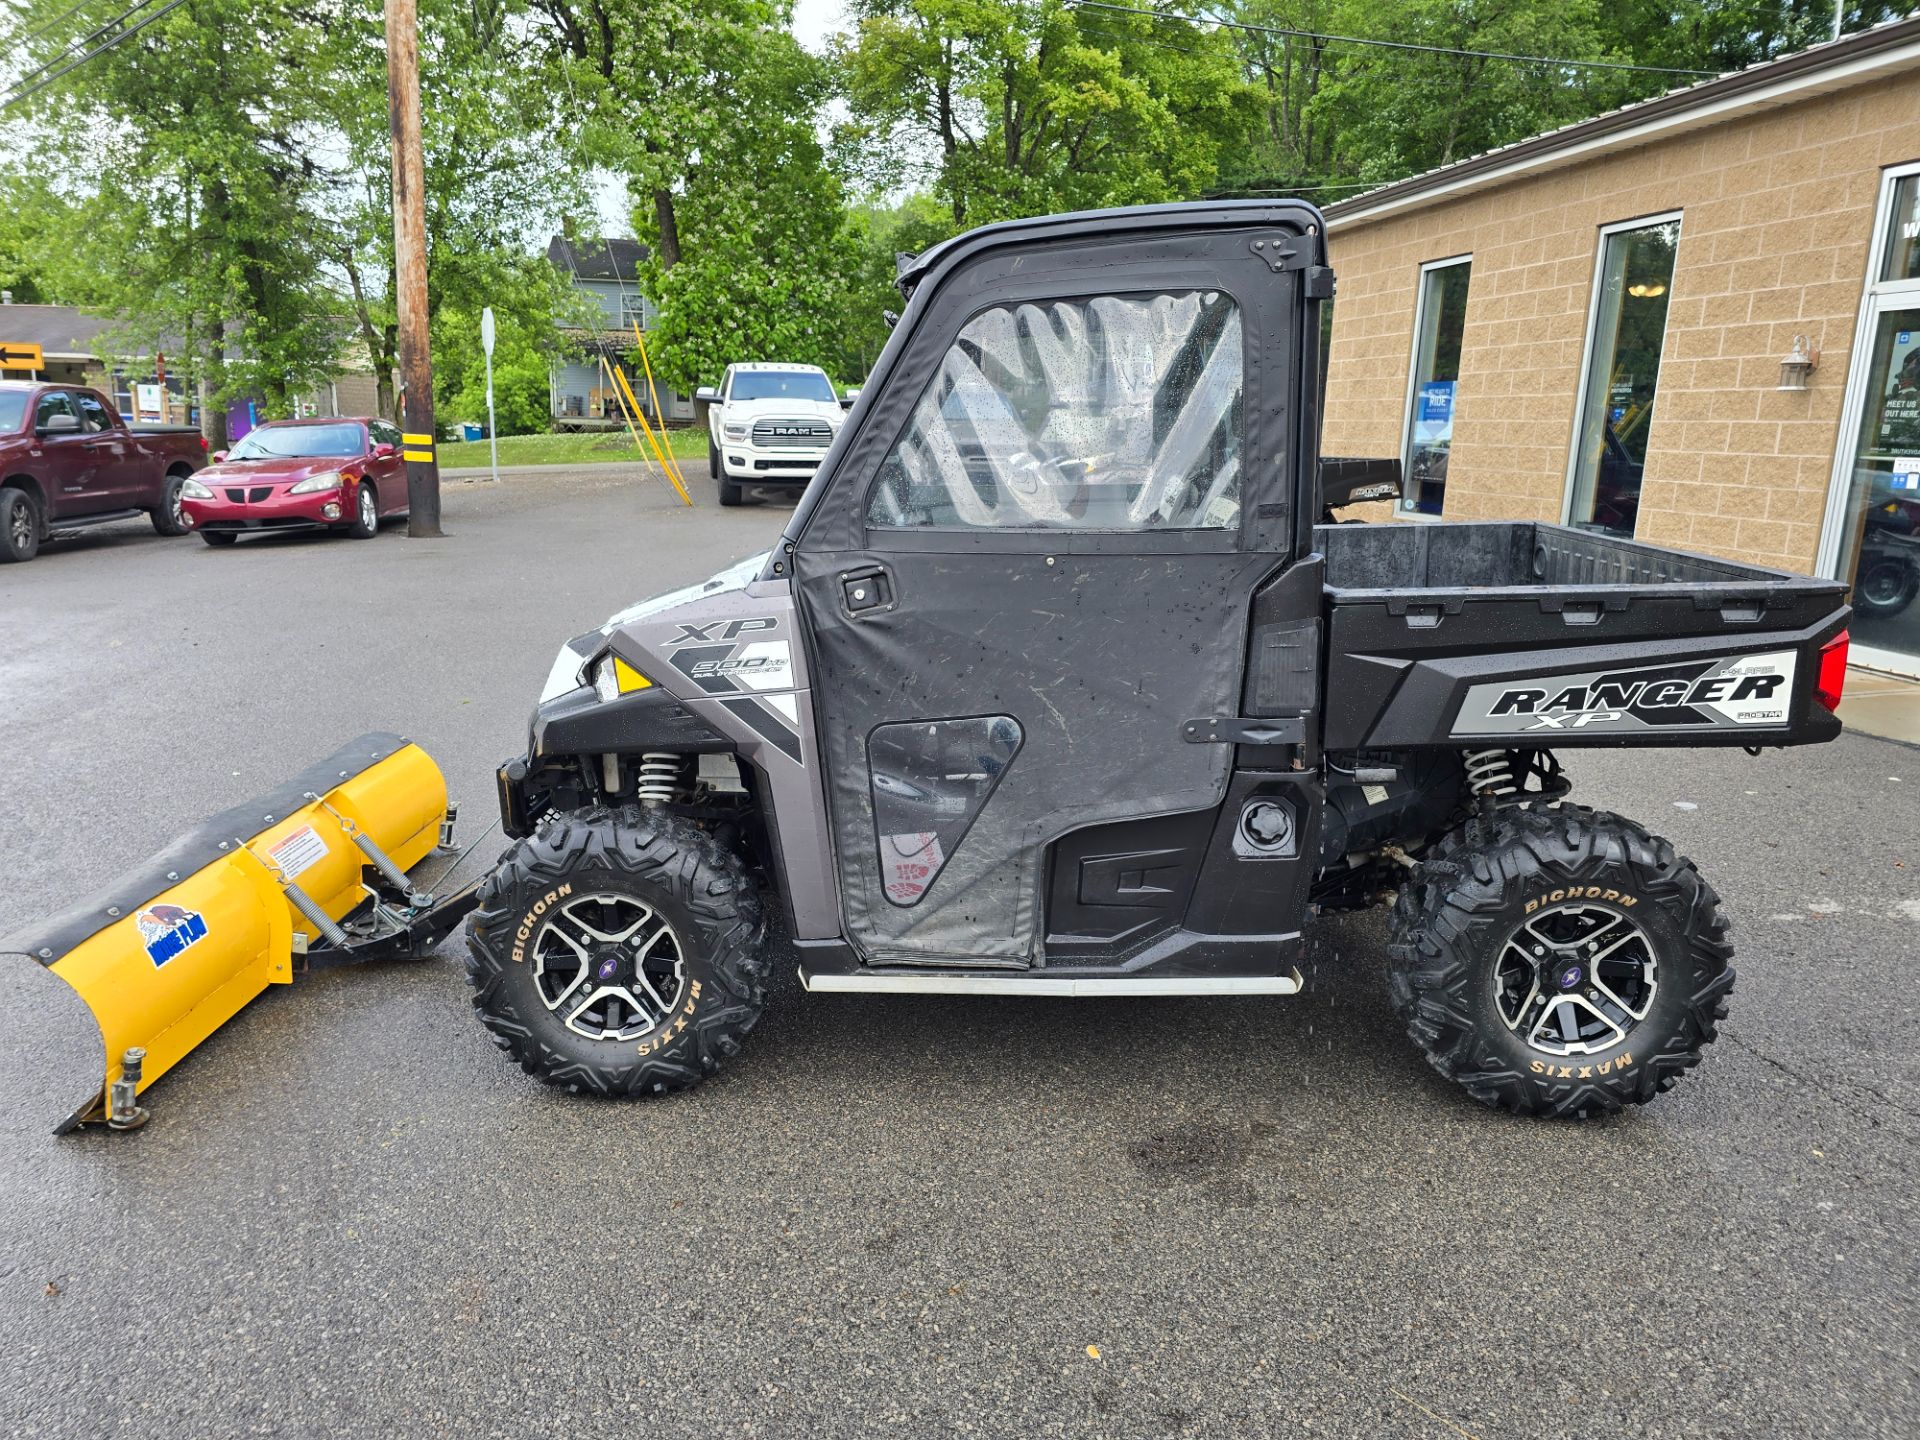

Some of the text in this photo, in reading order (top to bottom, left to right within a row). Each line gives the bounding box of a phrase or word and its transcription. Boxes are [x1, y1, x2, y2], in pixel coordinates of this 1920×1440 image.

[1429, 395, 1446, 407] RIDE
[1886, 400, 1917, 408] MEET US
[1884, 410, 1920, 418] OUT HERE.
[775, 427, 810, 435] RAM
[660, 616, 779, 646] XP
[691, 656, 769, 674] 900
[1720, 665, 1775, 677] POLARIS
[1486, 674, 1785, 717] RANGER
[1518, 711, 1623, 731] XP
[1737, 710, 1782, 719] PROSTAR
[1524, 886, 1638, 914] BIGHORN
[512, 882, 572, 962] BIGHORN
[637, 979, 703, 1056] MAXXIS
[1529, 1052, 1633, 1078] MAXXIS
